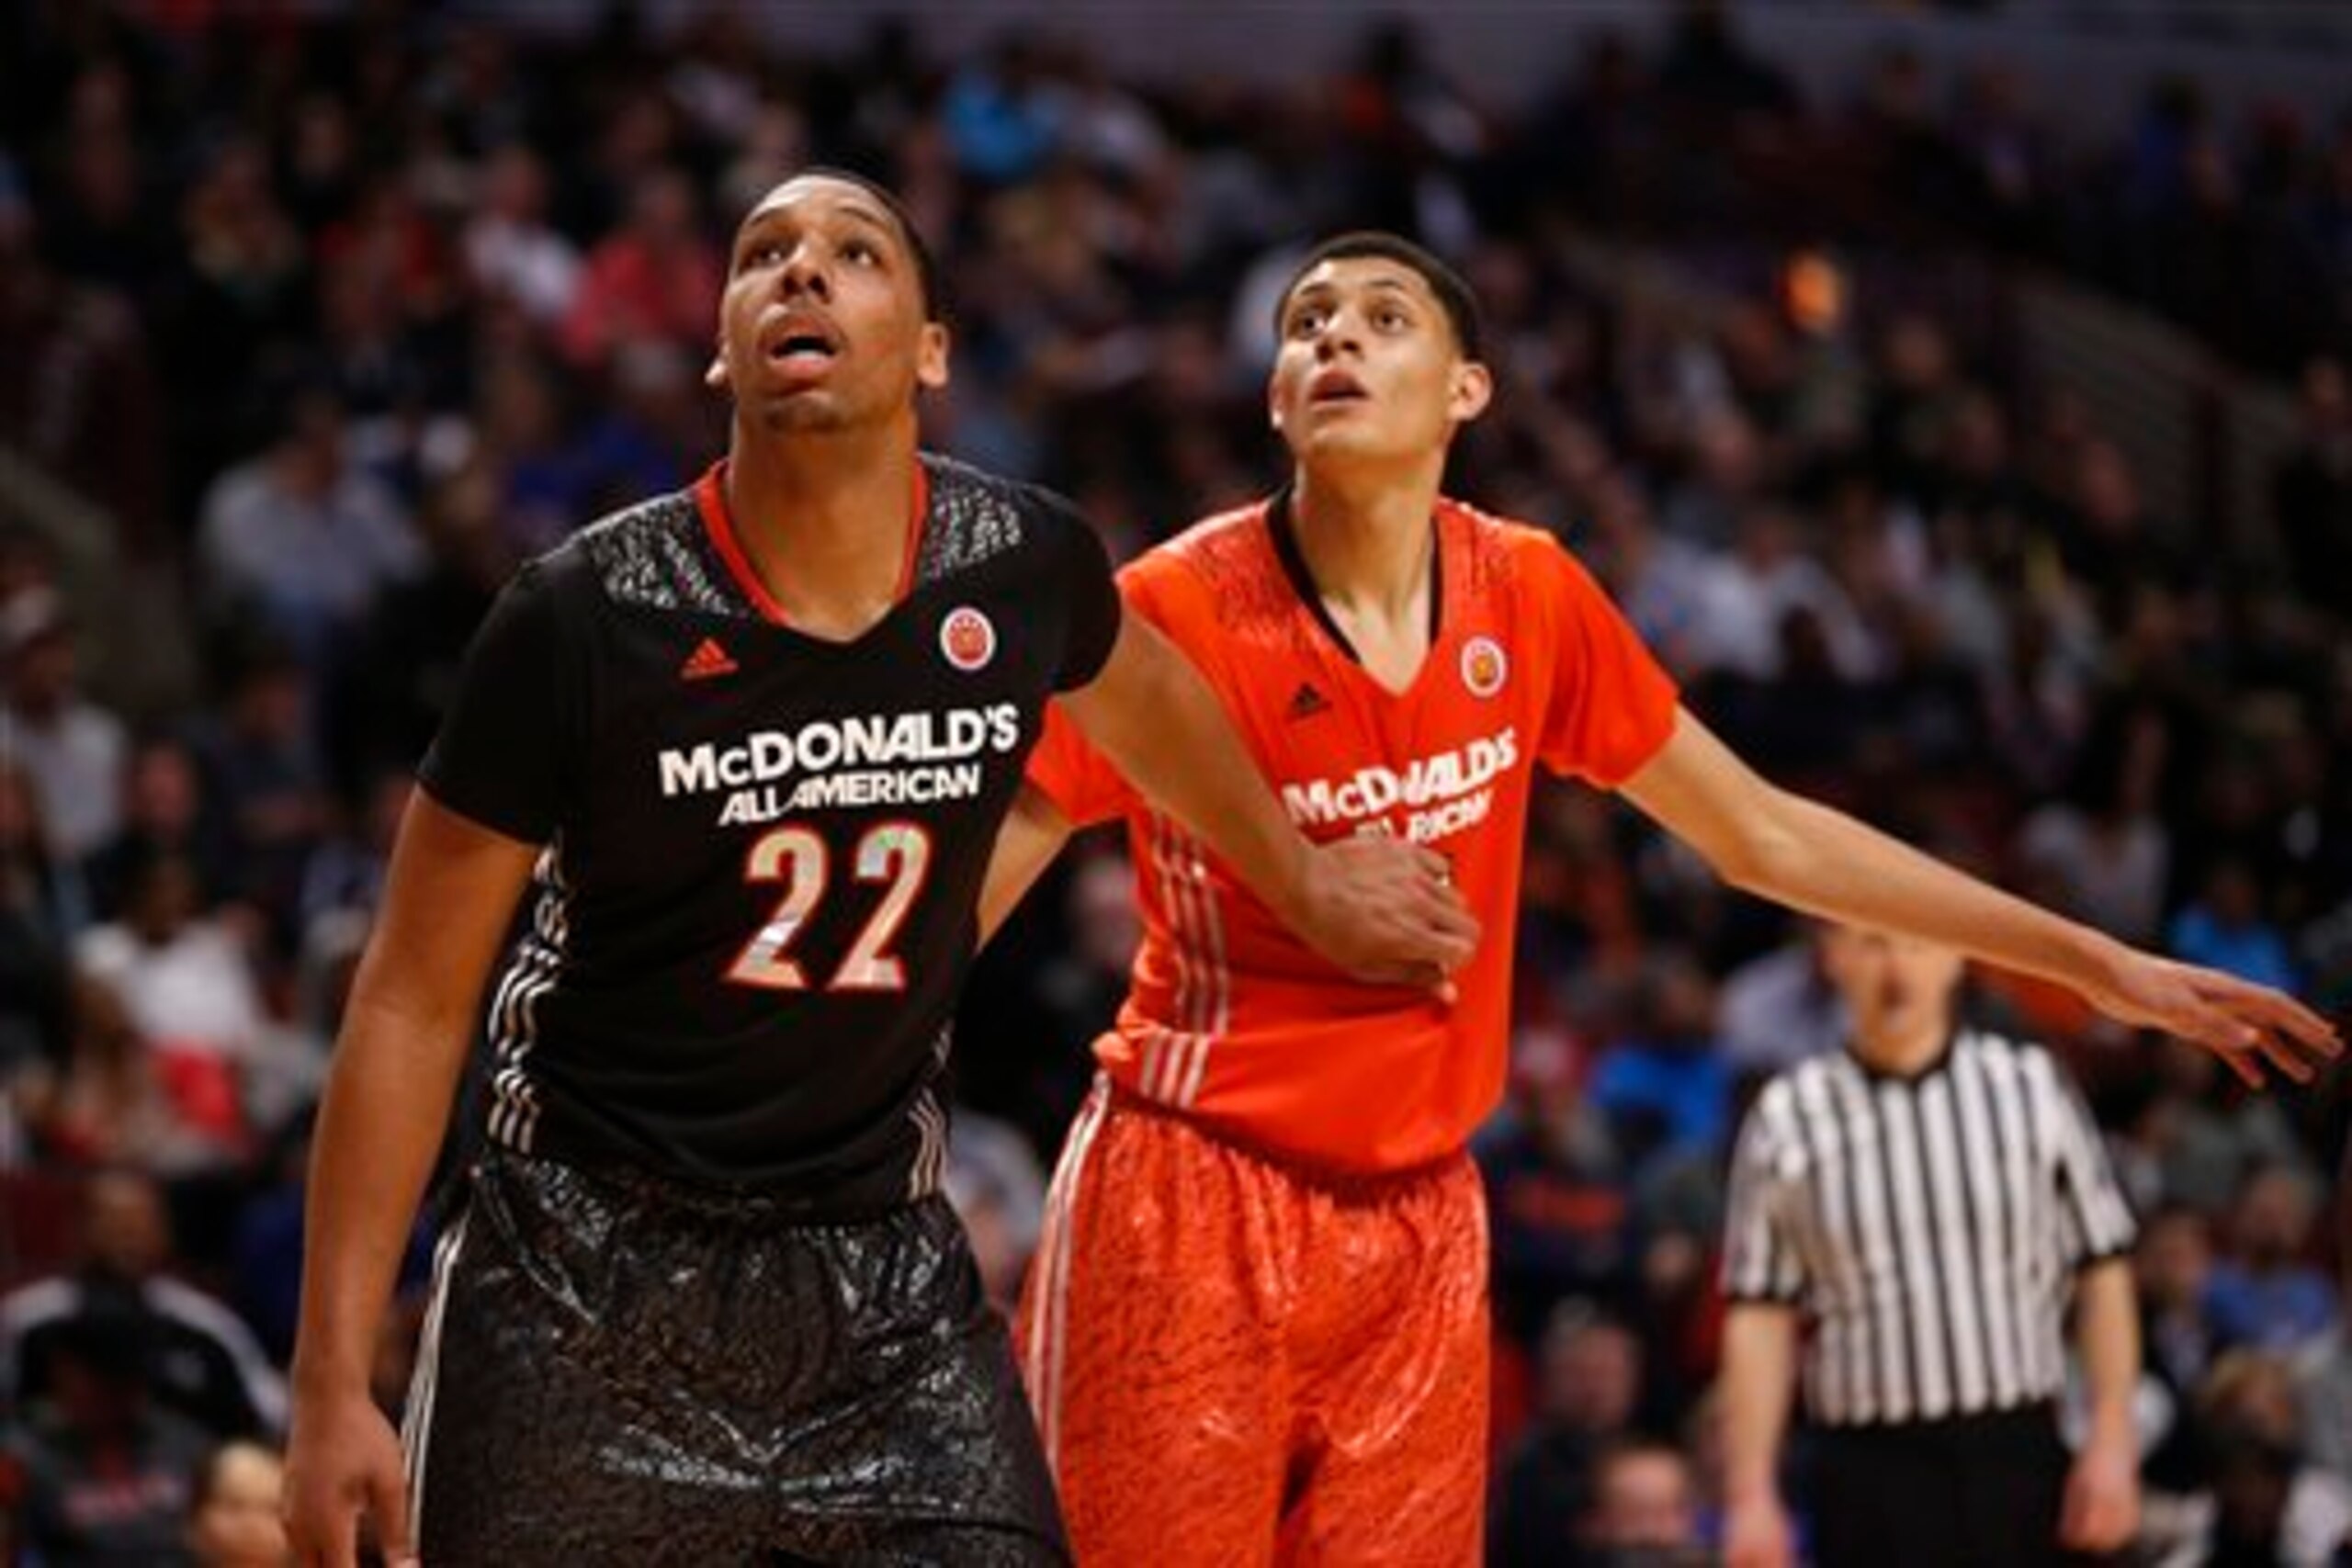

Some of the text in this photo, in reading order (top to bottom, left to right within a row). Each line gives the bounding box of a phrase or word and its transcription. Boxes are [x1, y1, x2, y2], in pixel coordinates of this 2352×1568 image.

[659, 703, 1020, 796] McDONALD'S
[718, 764, 982, 826] ALL AMERICAN
[1282, 726, 1519, 823] McDALD'S
[724, 823, 932, 989] 22
